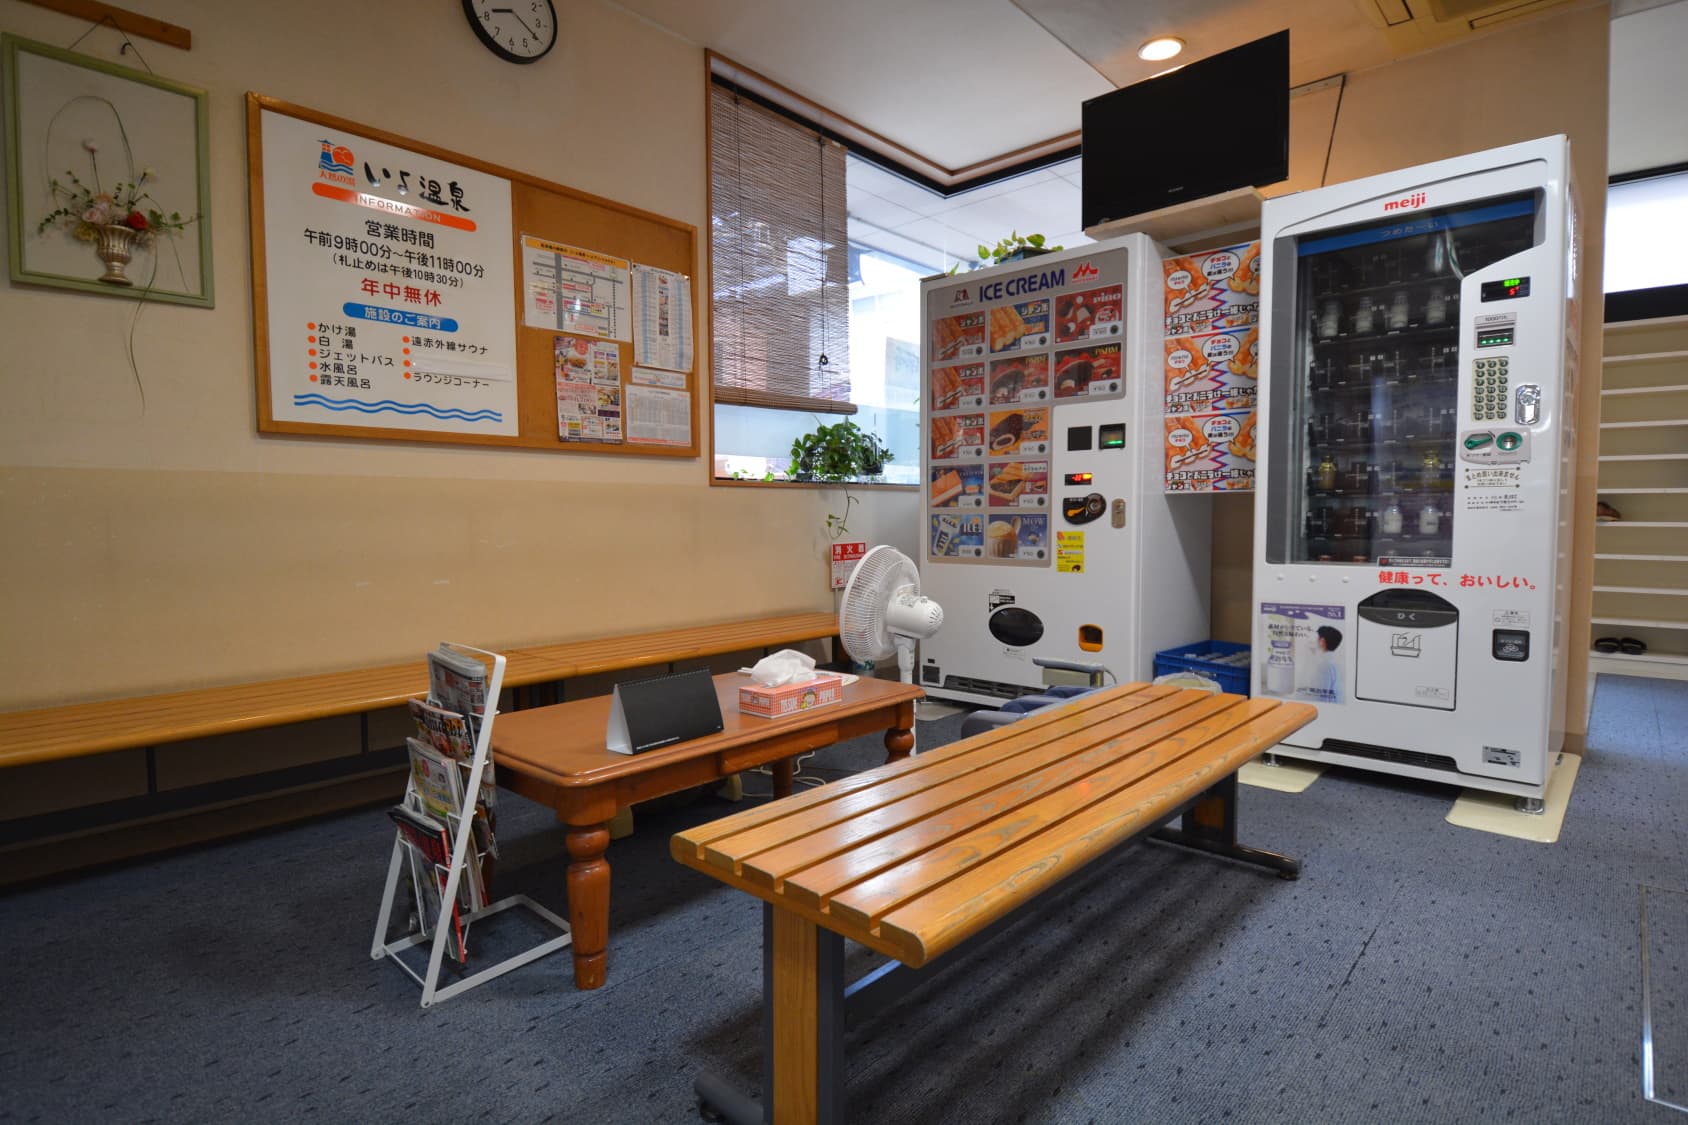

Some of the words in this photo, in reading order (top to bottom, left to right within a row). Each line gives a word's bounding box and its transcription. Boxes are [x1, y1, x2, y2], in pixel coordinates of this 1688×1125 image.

[531, 3, 537, 12] 2
[484, 11, 490, 21] 8
[536, 18, 541, 28] 3
[495, 26, 501, 36] 7
[509, 37, 515, 46] 6
[522, 38, 528, 48] 5
[1384, 192, 1426, 211] meiji
[365, 219, 435, 249] 営業時間
[361, 278, 442, 307] 年中無休
[979, 281, 1003, 303] ICE
[1006, 268, 1065, 297] CREAM
[364, 306, 442, 330] 施設のご案内
[318, 323, 357, 338] かけ湯
[411, 335, 489, 355] 遠赤外線サウナ
[319, 348, 395, 367] ジェットバス
[320, 361, 358, 376] 水風呂
[320, 374, 371, 389] 露天風呂
[413, 372, 489, 388] ラウンジコーナー
